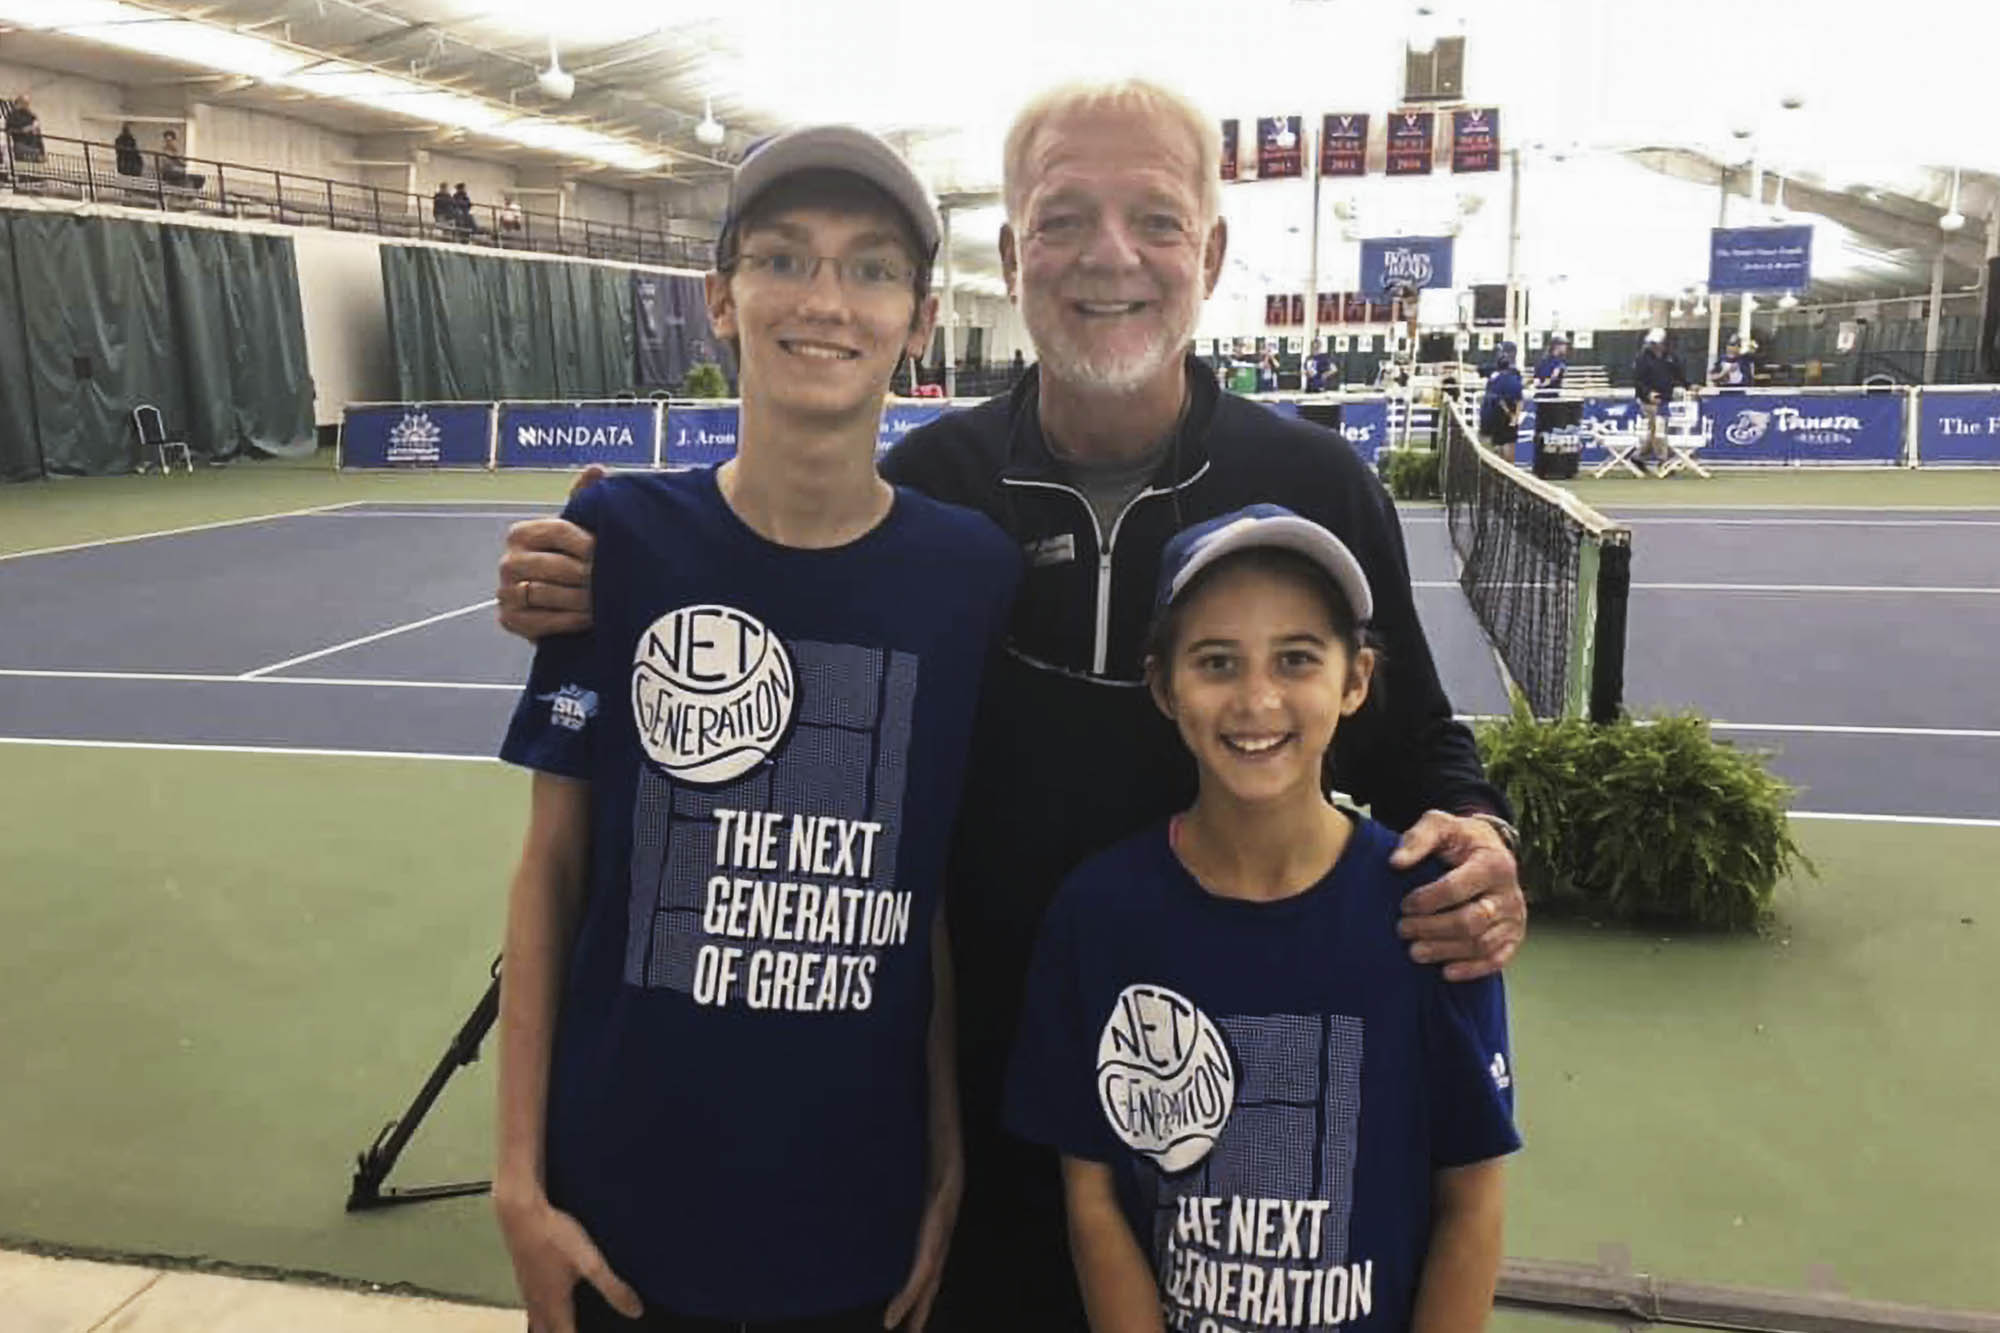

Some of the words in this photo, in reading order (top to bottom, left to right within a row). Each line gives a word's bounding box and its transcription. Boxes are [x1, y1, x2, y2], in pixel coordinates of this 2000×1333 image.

[676, 428, 691, 447] J.
[1939, 417, 1981, 435] The
[649, 608, 761, 682] NET
[636, 647, 790, 756] GENERATION
[713, 808, 784, 870] THE
[788, 814, 882, 878] NEXT
[703, 876, 912, 946] GENERATION
[693, 944, 744, 1007] OF
[746, 950, 877, 1011] GREATS
[1111, 989, 1191, 1067] NET
[1227, 1195, 1330, 1260] NEXT
